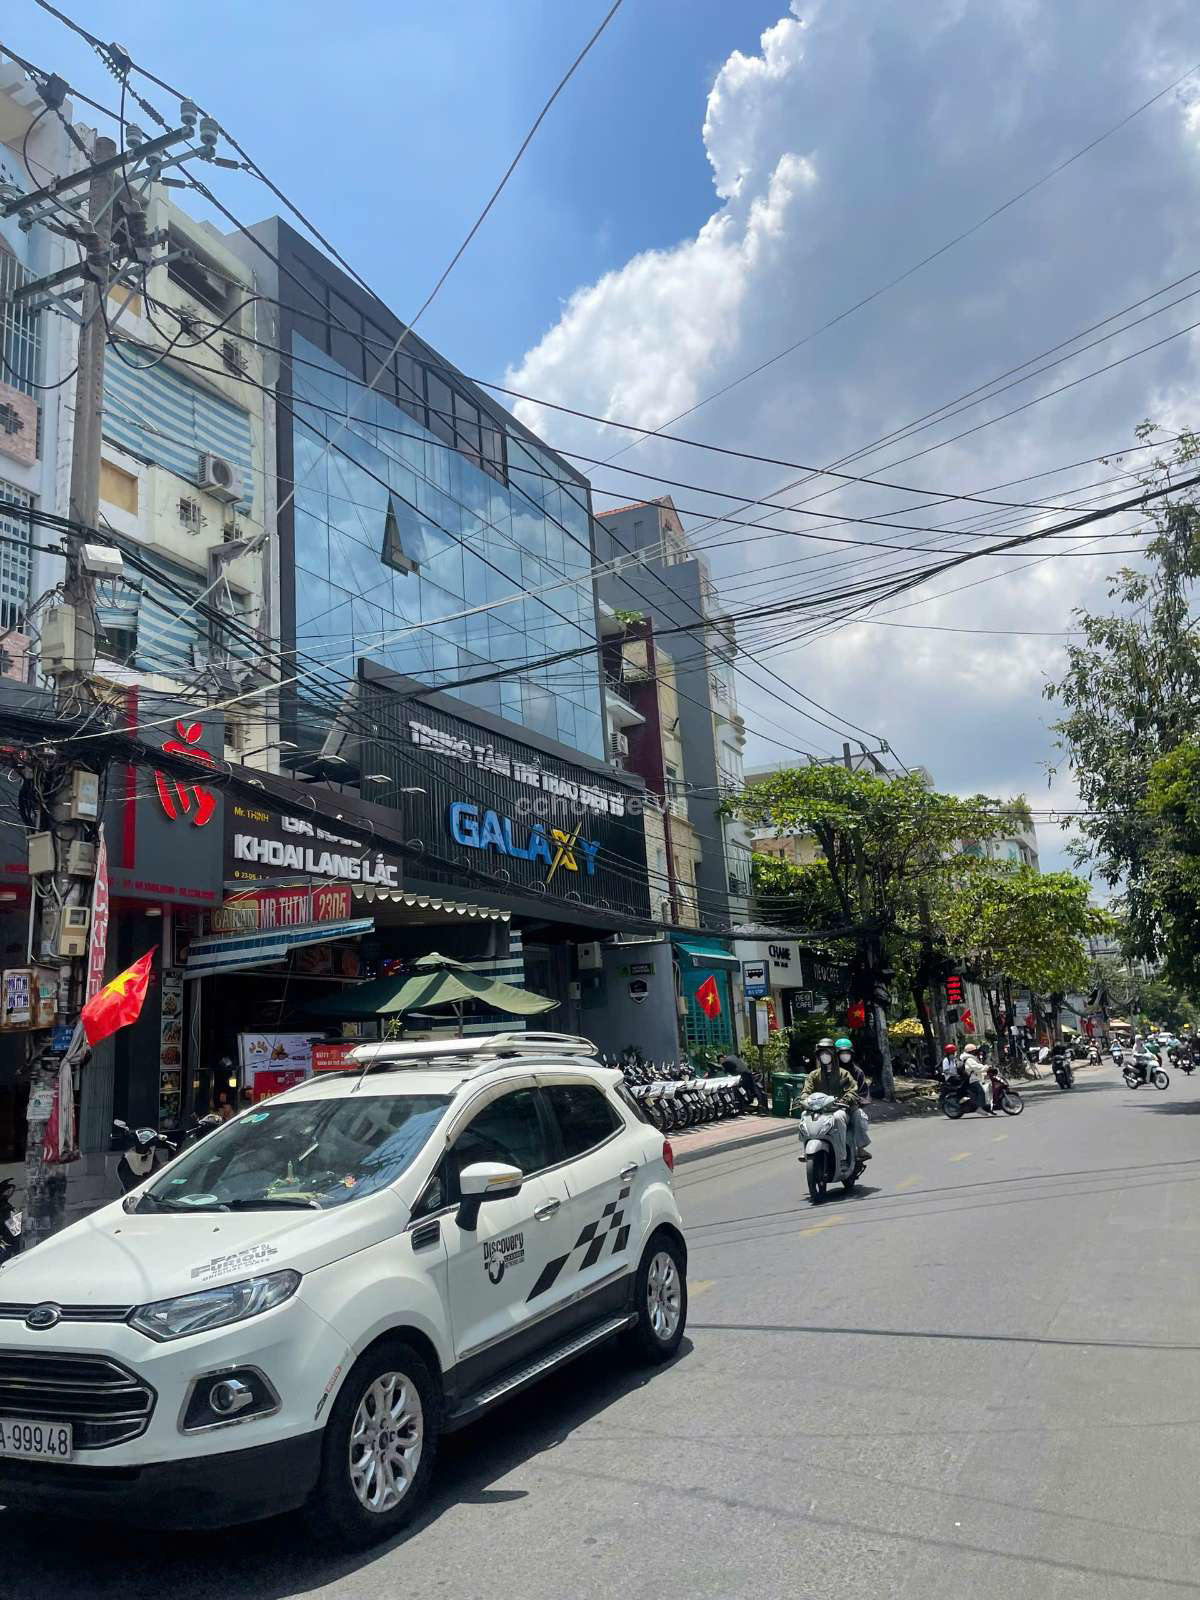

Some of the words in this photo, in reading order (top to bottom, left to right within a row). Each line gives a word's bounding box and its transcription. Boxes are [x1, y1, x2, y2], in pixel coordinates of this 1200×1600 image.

[234, 833, 304, 870] KHOAI
[305, 848, 361, 881] LANG
[362, 853, 399, 888] LẮC
[449, 800, 601, 885] GALAXY
[319, 892, 347, 921] 2305
